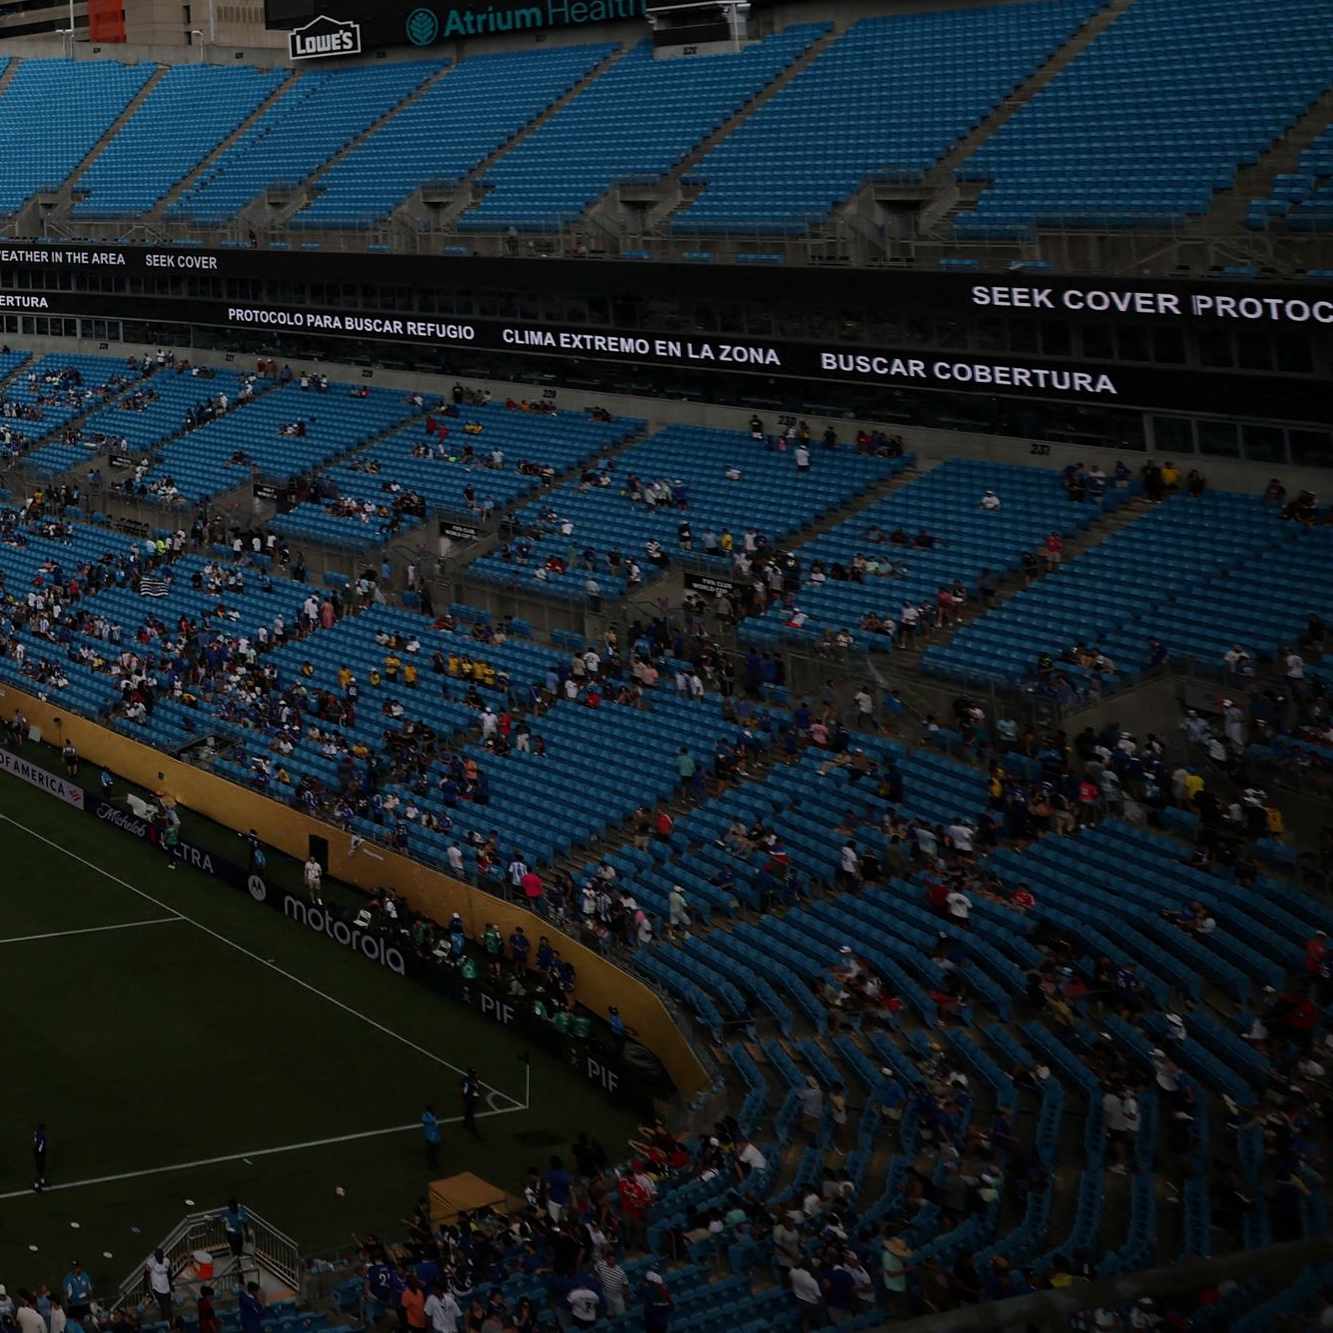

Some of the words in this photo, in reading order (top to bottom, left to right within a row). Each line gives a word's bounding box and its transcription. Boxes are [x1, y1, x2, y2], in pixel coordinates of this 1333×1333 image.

[443, 5, 543, 38] Atrium
[295, 29, 354, 54] LOWE'S
[52, 252, 62, 262] IN
[66, 252, 89, 263] THE
[92, 253, 125, 265] AREA
[146, 254, 175, 267] SEEK
[178, 256, 217, 269] COVER
[973, 286, 1054, 308] SEEK
[1063, 290, 1181, 314] COVER
[229, 308, 303, 325] PROTOCOLO
[307, 314, 342, 329] PARA
[345, 317, 403, 334] BUSCAR
[407, 322, 474, 339] REFUGIO
[503, 329, 556, 346] CLIMA
[560, 333, 649, 354] EXTREMO
[655, 340, 681, 357] EN
[687, 343, 715, 359] LA
[719, 345, 780, 365] ZONA
[821, 353, 926, 377] BUSCAR
[933, 362, 1117, 394] COBERTURA
[543, 390, 557, 398] 229
[779, 415, 798, 426] 230
[1030, 443, 1051, 455] 231
[13, 760, 64, 796] AMERICA
[96, 802, 146, 838] Michelob
[284, 895, 405, 975] motorola
[481, 993, 514, 1024] PIF
[587, 1056, 618, 1092] PIF
